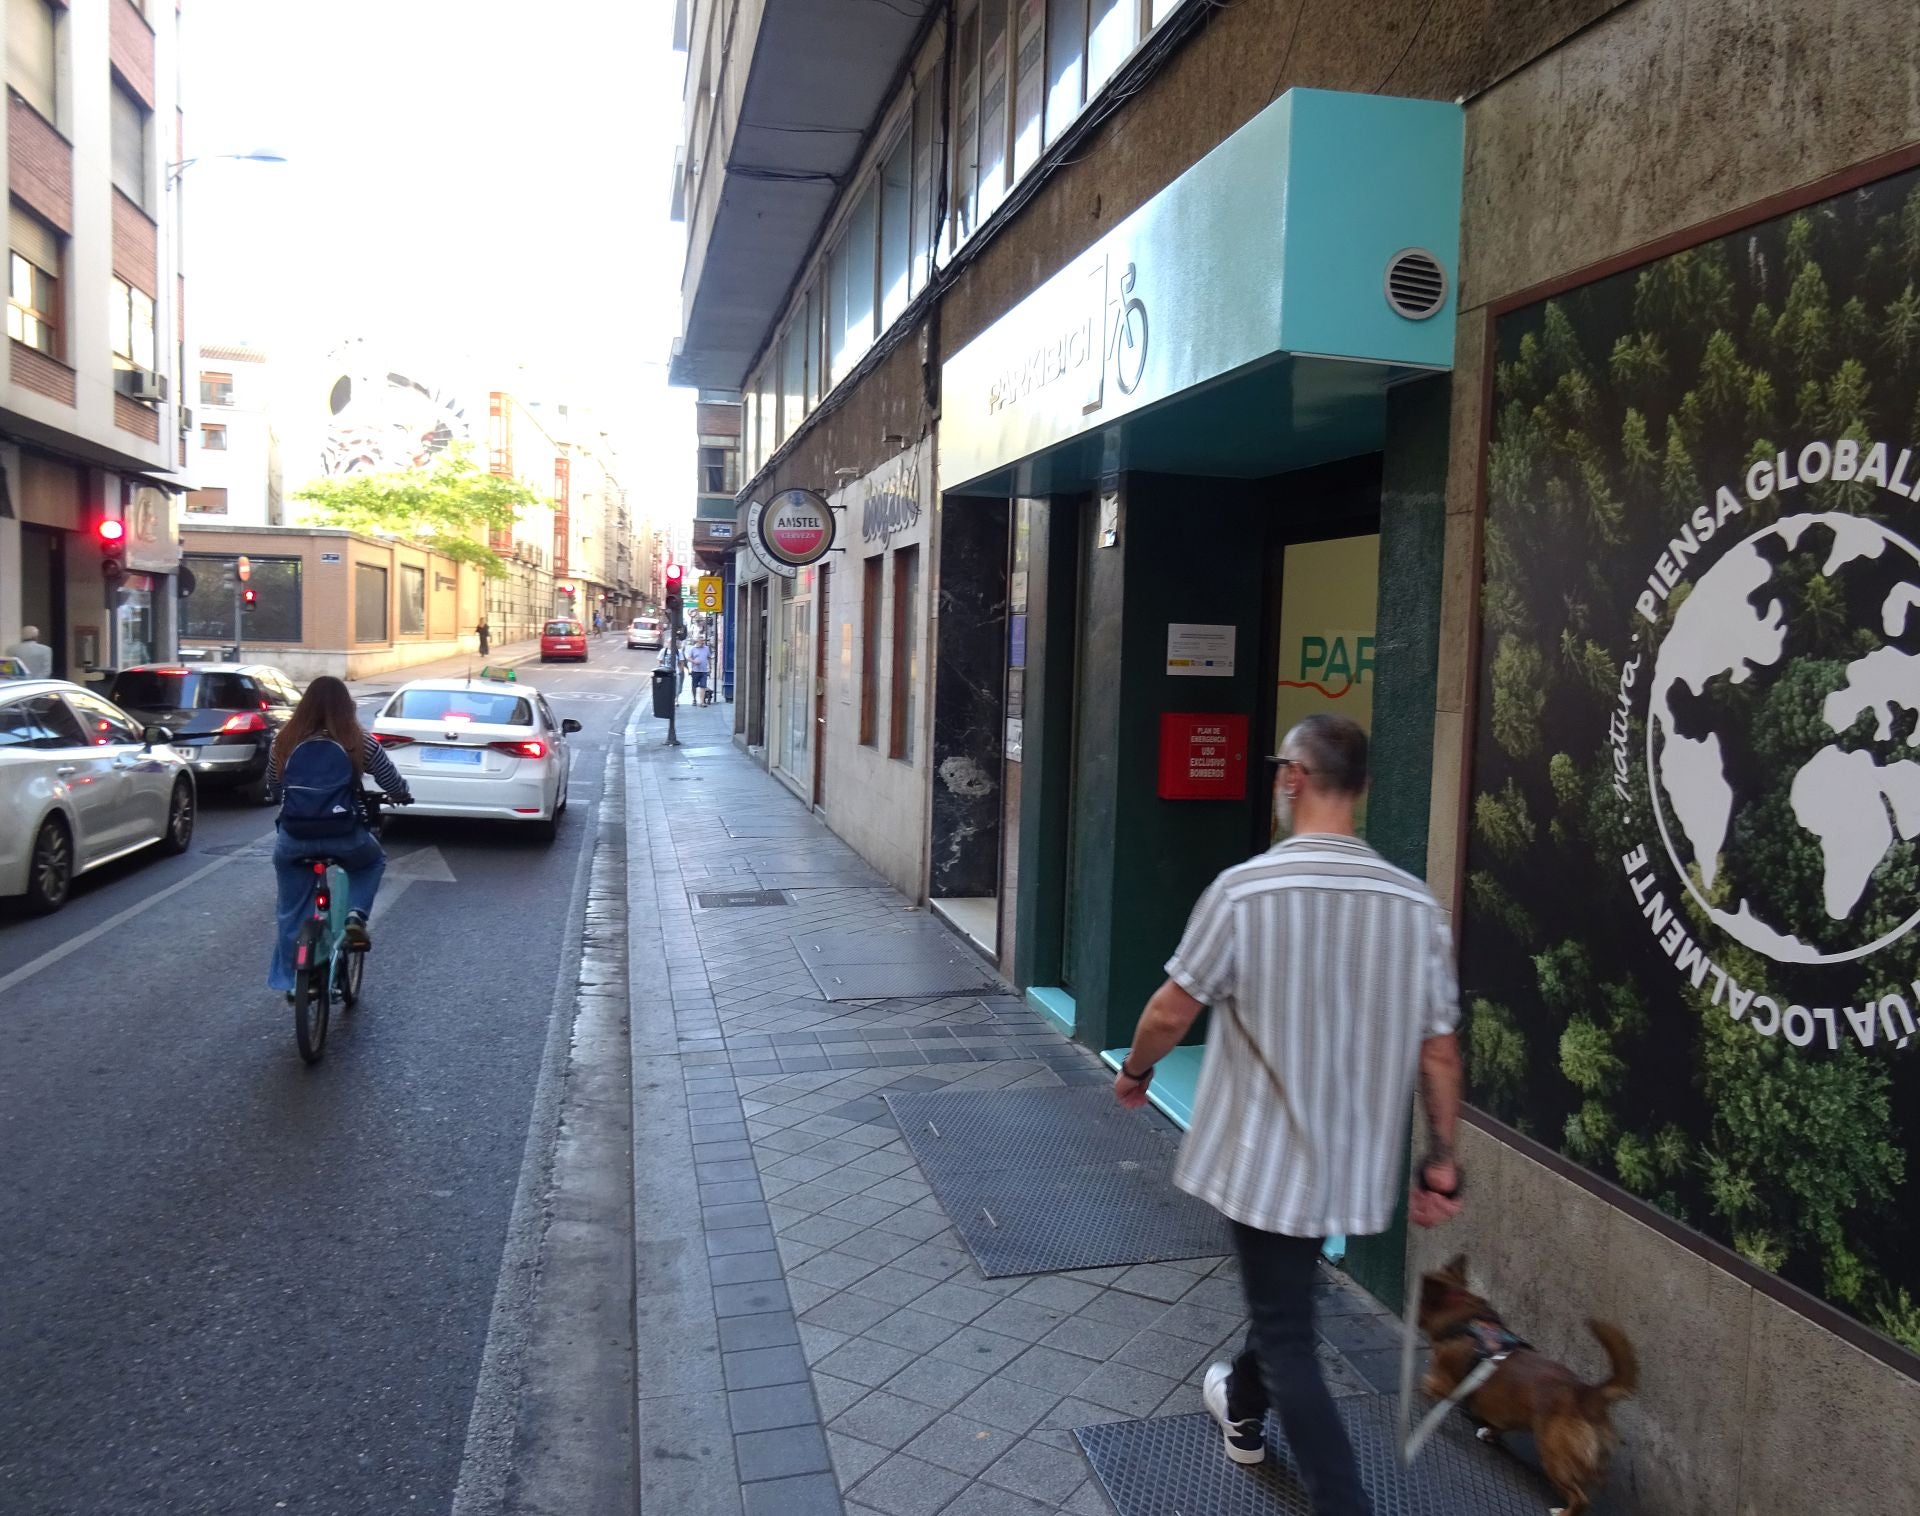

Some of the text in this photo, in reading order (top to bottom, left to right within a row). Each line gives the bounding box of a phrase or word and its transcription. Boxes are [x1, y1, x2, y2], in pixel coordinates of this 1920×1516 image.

[777, 517, 820, 528] AMSTEL
[1635, 439, 1920, 624] PIENSA GLOBAL
[1197, 727, 1221, 735] PLAN DE
[1608, 652, 1642, 802] natura
[1191, 735, 1227, 743] EMERGENCIA
[1201, 746, 1216, 756] USO
[1190, 757, 1226, 767] EXCLUSIVO
[1189, 768, 1225, 778] BOMBEROS
[1621, 843, 1838, 1050] LOCALMENTE
